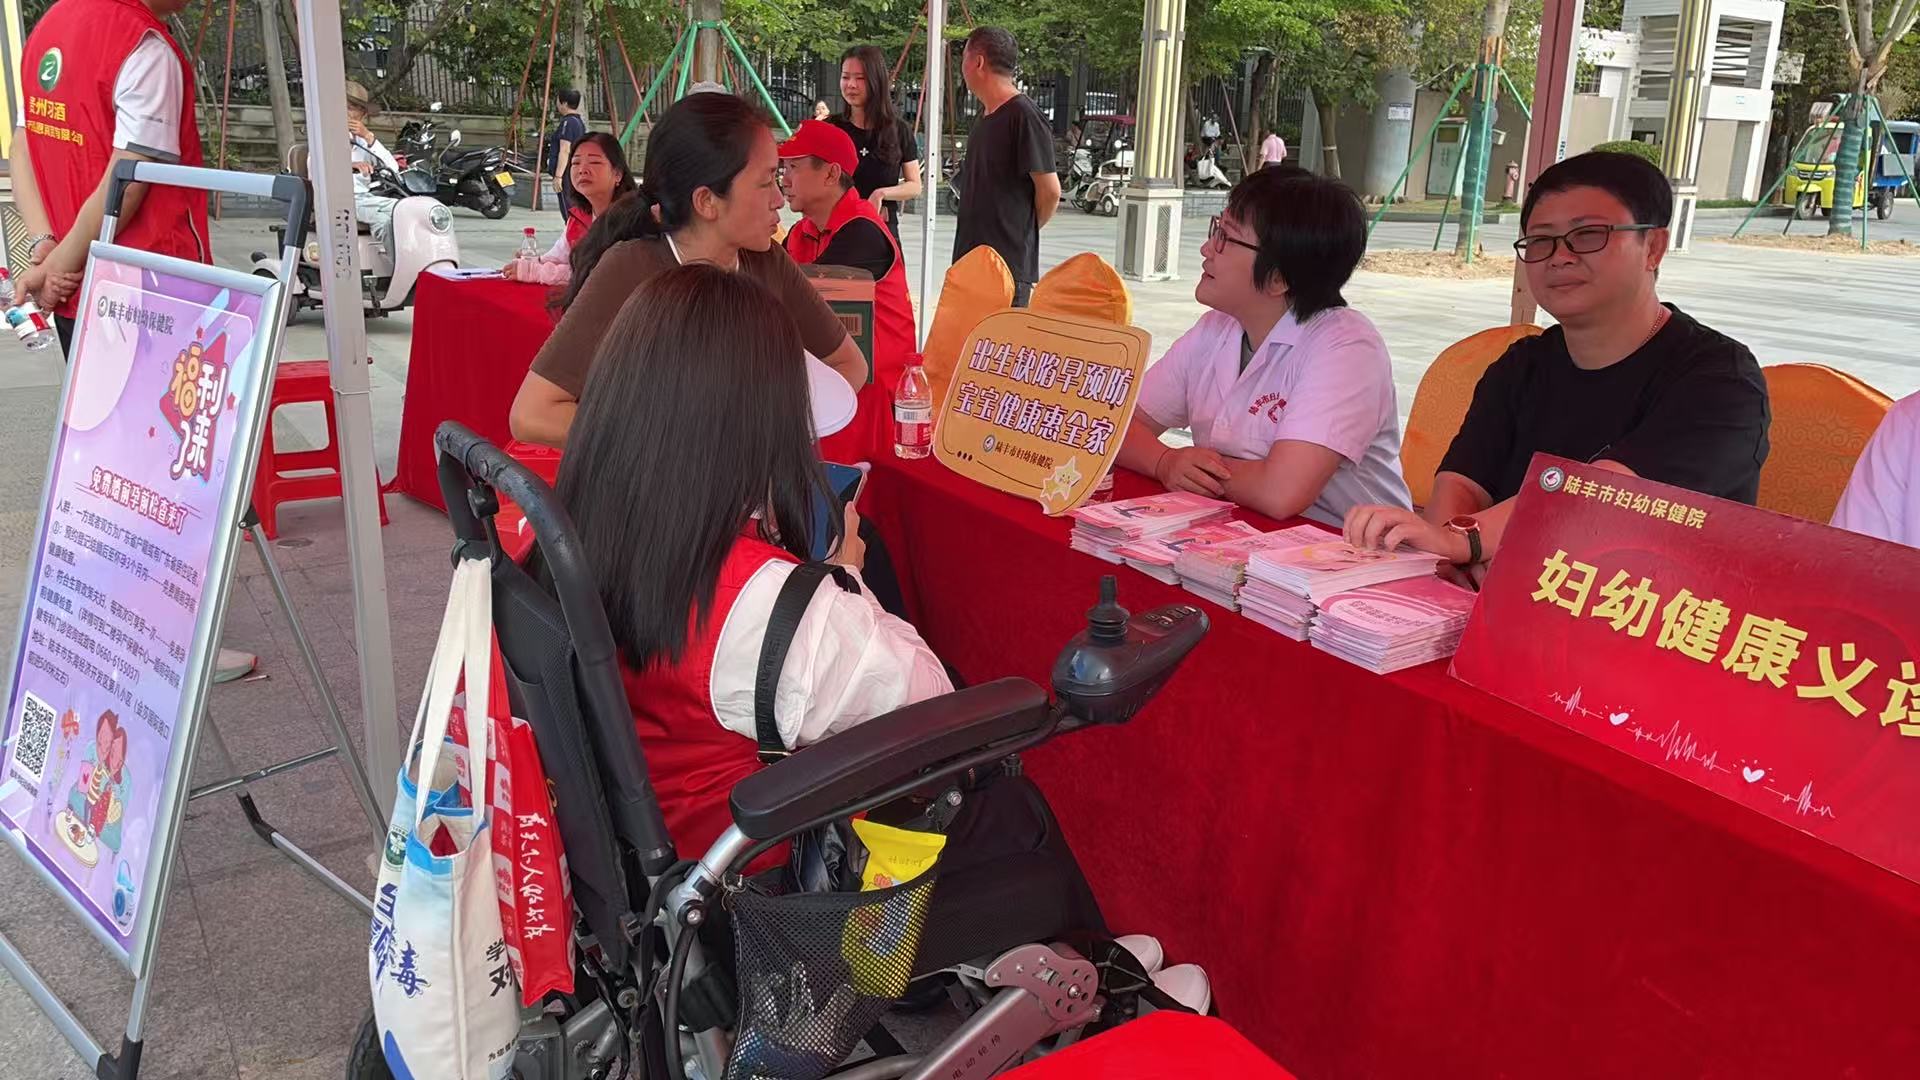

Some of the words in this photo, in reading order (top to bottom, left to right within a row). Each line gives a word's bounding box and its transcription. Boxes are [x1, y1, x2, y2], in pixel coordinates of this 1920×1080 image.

[108, 301, 174, 335] 陆丰市妇幼保健院
[968, 338, 1134, 407] 出生缺陷早预防
[953, 381, 1115, 456] 宝宝健康惠全家
[995, 441, 1053, 469] 陆丰市妇幼保健院
[91, 466, 188, 535] 免费婚前孕前检查来了
[1563, 475, 1707, 529] 陆丰市妇幼保健院
